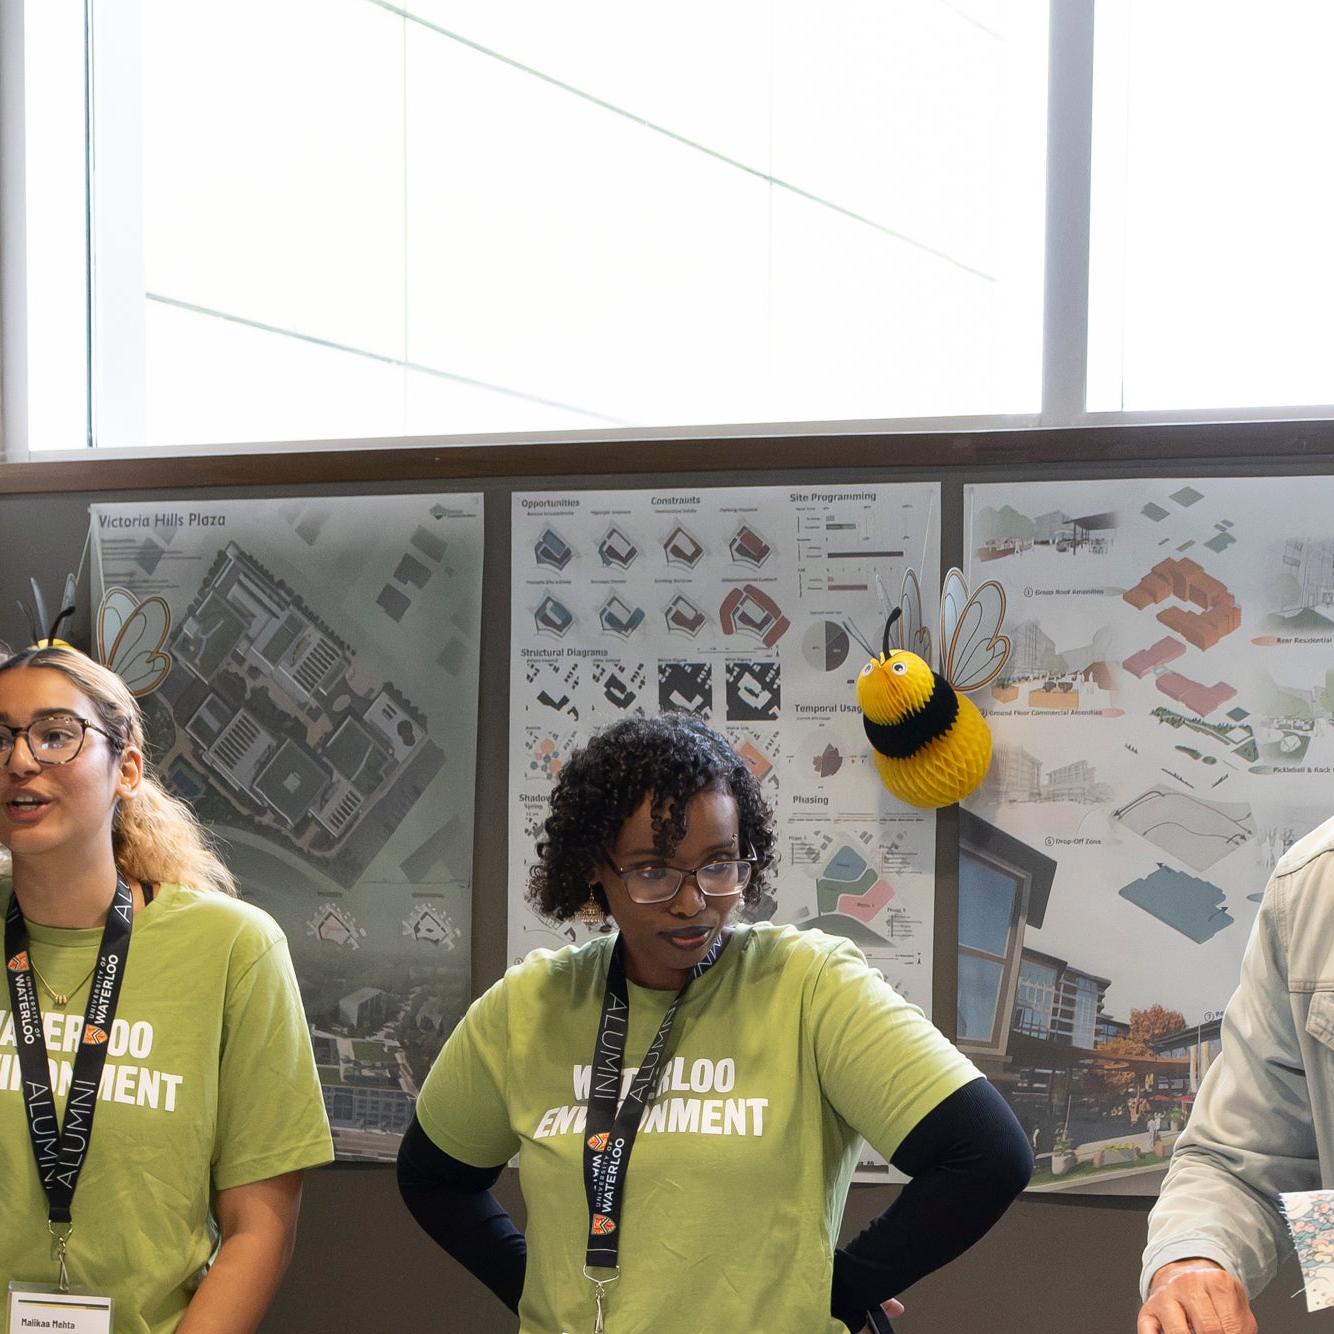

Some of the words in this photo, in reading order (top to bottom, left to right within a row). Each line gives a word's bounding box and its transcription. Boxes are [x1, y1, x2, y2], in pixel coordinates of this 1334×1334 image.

[521, 499, 580, 509] Opportunities
[651, 496, 701, 505] Constraints
[790, 493, 808, 503] Site
[811, 491, 877, 503] Programming
[99, 514, 150, 528] Victoria
[154, 513, 184, 528] Hills
[188, 512, 226, 527] Plaza
[521, 647, 565, 658] Structural
[567, 647, 609, 659] Diagrams
[795, 704, 837, 714] Temporal
[840, 704, 863, 714] Usag
[793, 795, 829, 805] Phasing
[25, 975, 39, 1024] UNIVERSITY
[34, 1027, 41, 1038] OF
[89, 970, 104, 1019] UNIVERSITY
[100, 956, 107, 967] OF
[94, 954, 119, 1025] WATERLOO
[14, 974, 35, 1045] WATERLOO
[594, 991, 628, 1100] ALUMNI
[56, 1079, 97, 1190] ALUMNI
[596, 1155, 610, 1208] UNIVERSITY
[606, 1140, 613, 1152] OF
[601, 1138, 625, 1213] WATERLOO
[52, 1319, 76, 1330] Mehta
